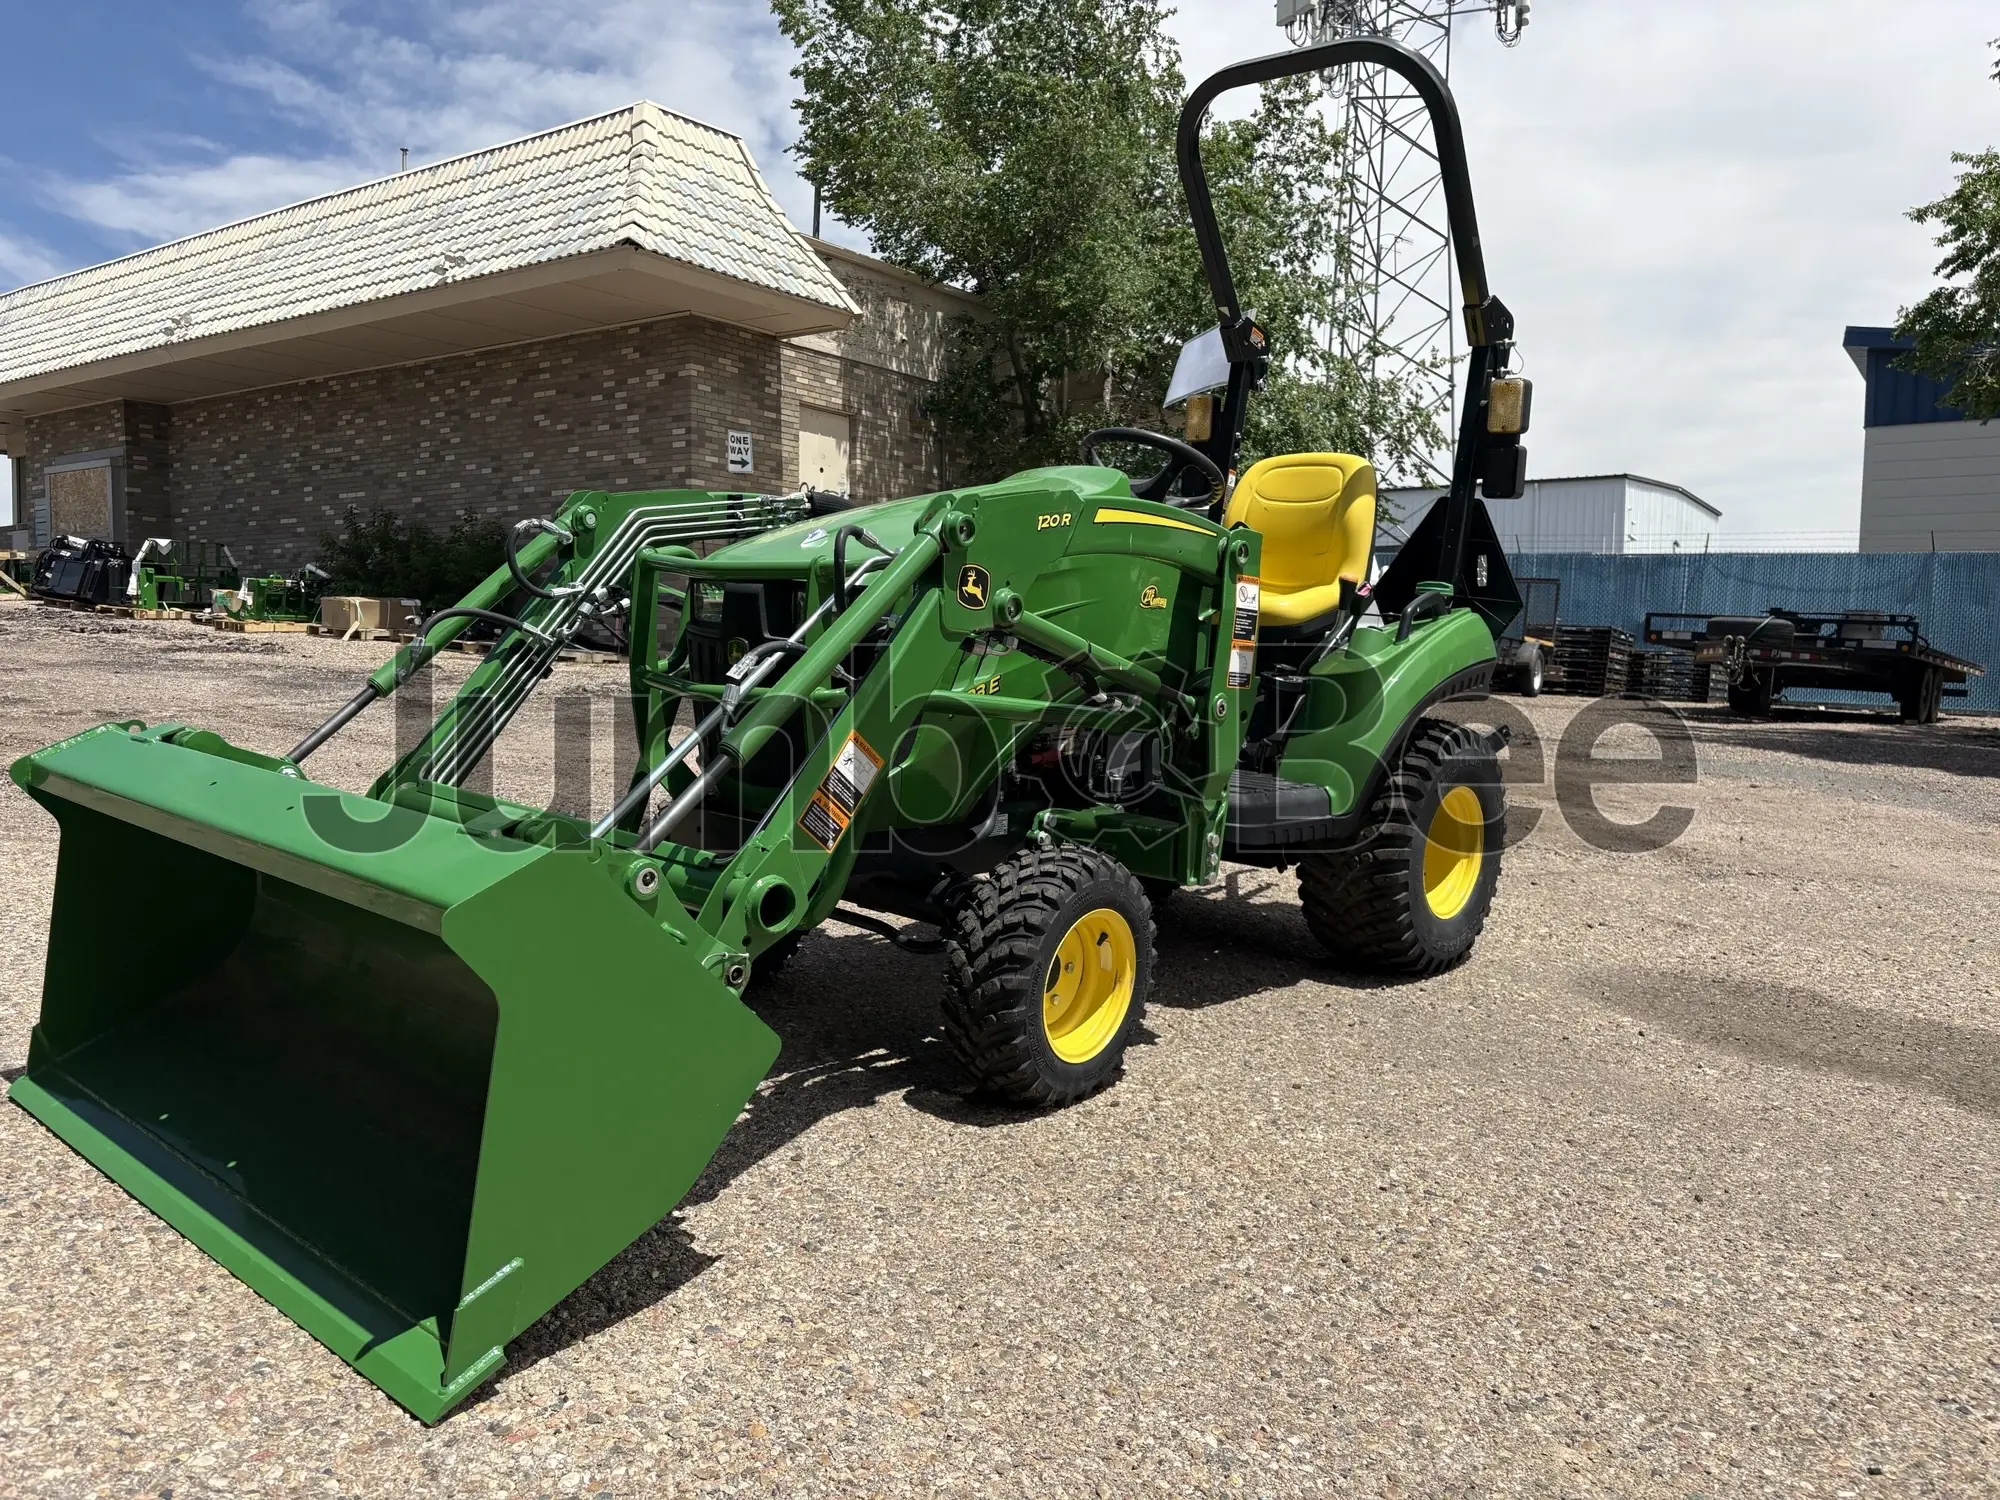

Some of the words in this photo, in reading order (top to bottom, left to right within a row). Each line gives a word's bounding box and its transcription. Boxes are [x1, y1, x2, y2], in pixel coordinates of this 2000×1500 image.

[730, 435, 749, 445] ONE
[730, 446, 750, 456] WAY
[859, 742, 880, 765] WARNING
